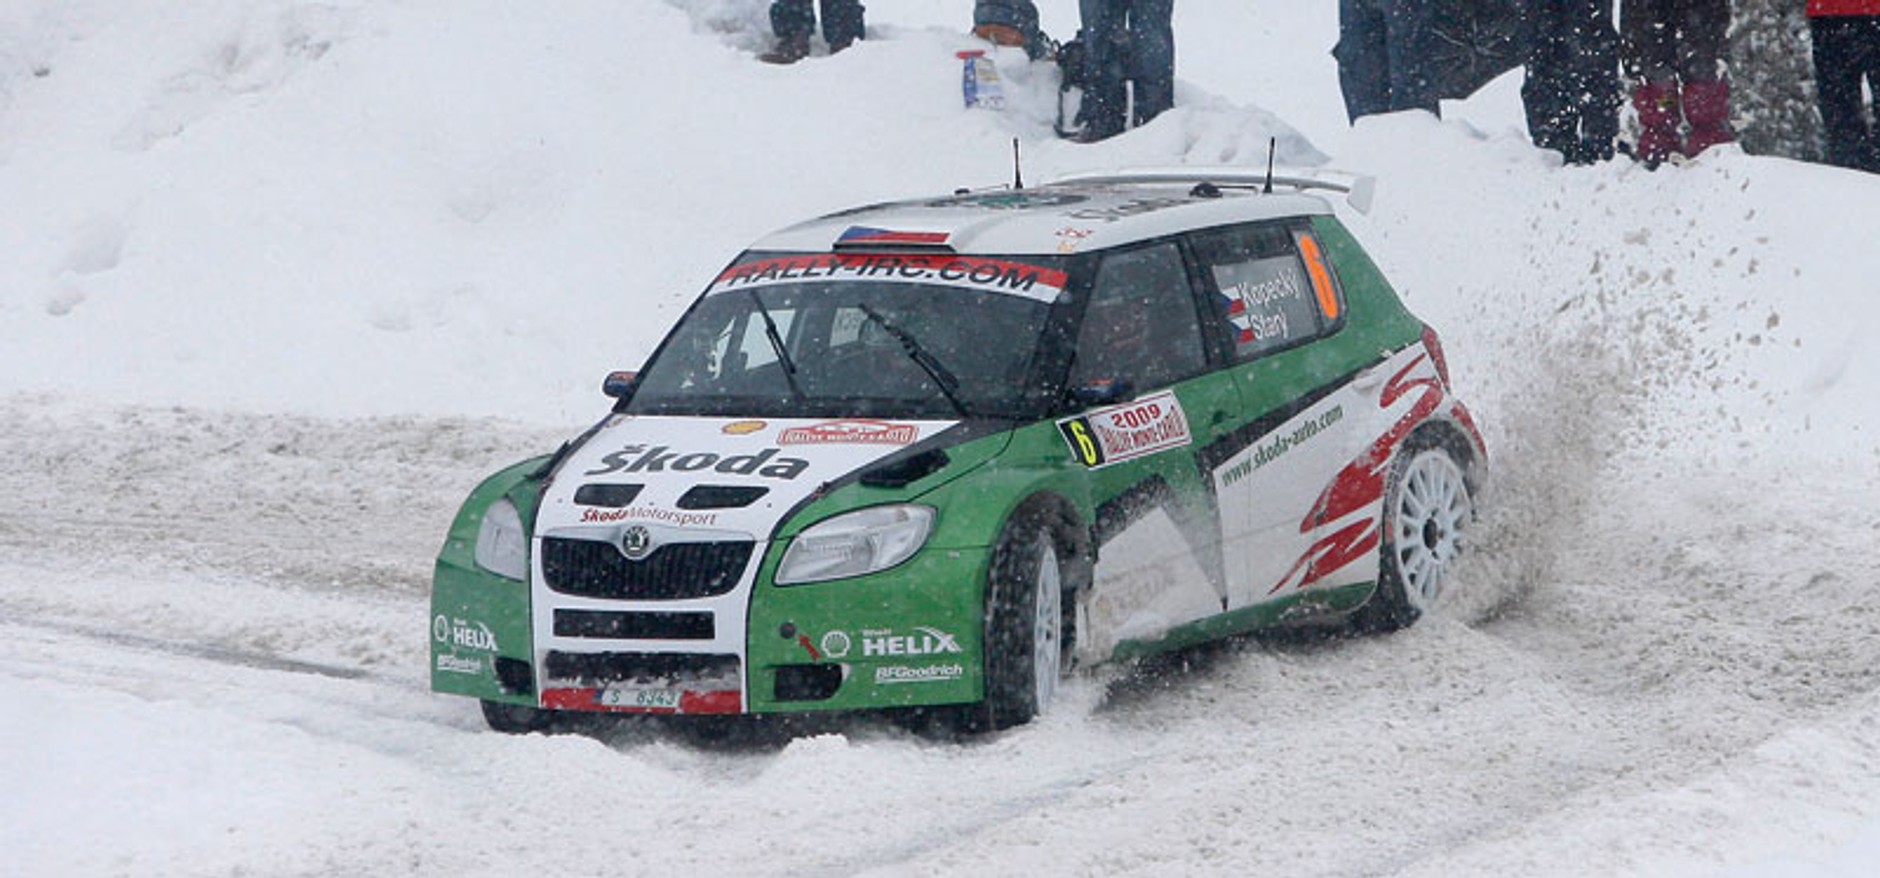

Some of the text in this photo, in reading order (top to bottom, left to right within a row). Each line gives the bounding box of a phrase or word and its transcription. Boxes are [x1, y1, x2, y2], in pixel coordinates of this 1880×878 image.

[729, 255, 1038, 292] RALLY-IRC.COM
[1238, 268, 1299, 308] Kopecký
[1300, 234, 1338, 319] 6
[1250, 305, 1289, 340] Starý
[1110, 403, 1161, 429] 2009
[1069, 419, 1097, 466] 6
[1221, 403, 1343, 487] www.skoda-auto.com
[584, 444, 810, 480] Škoda
[453, 621, 499, 651] HELIX
[862, 627, 962, 656] HELIX
[876, 664, 962, 683] BFGoodrich
